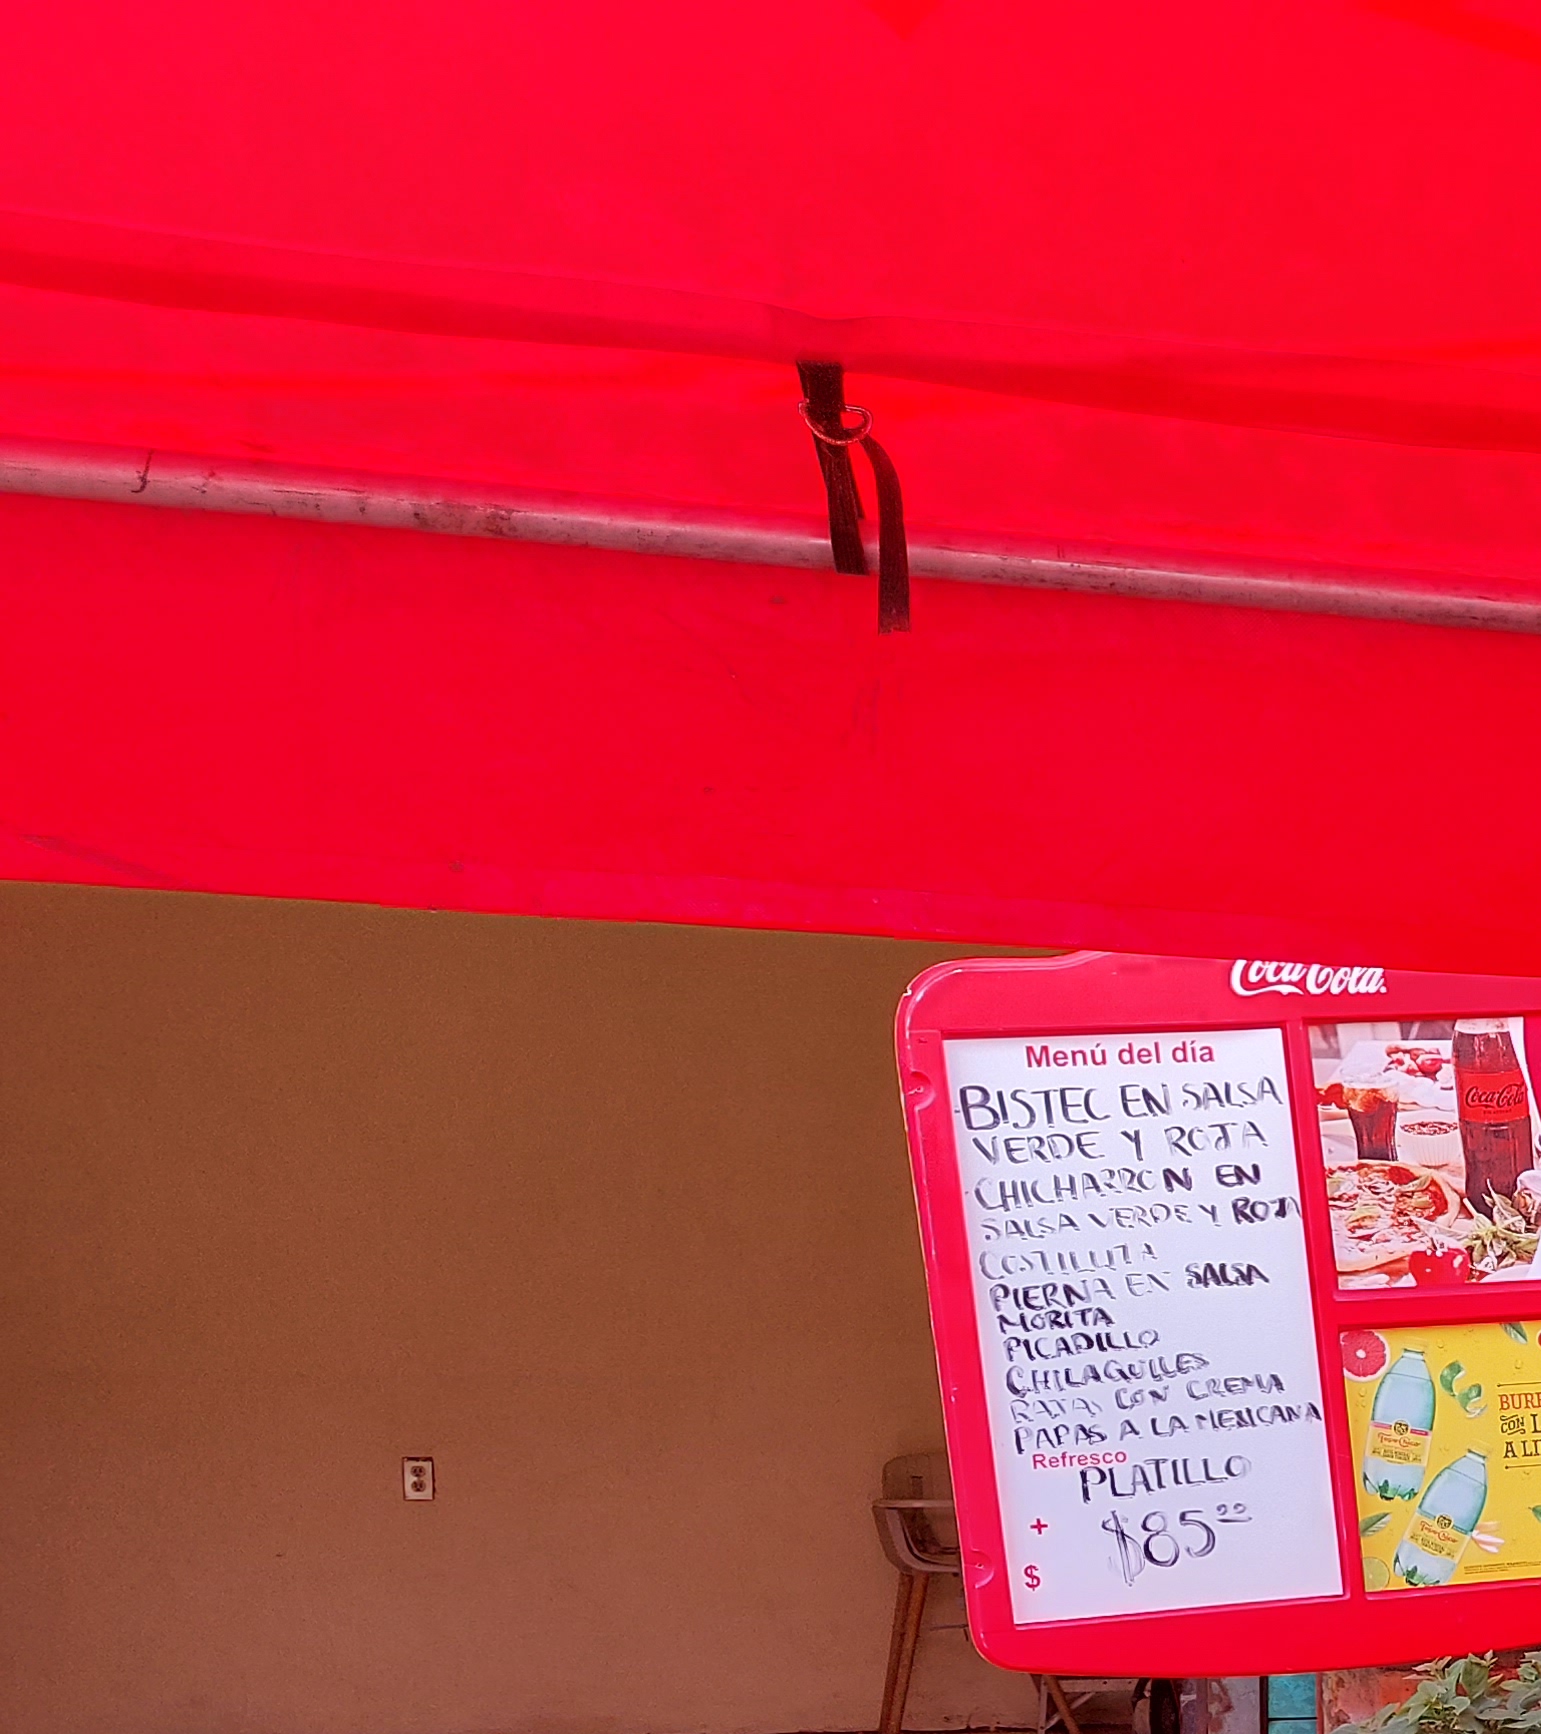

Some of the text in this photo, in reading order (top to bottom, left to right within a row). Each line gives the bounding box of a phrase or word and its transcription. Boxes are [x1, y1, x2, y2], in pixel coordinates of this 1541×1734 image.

[1025, 1040, 1215, 1068] Menú del día
[960, 1076, 1283, 1130] BISTEC EN SALSA
[973, 1131, 1104, 1165] VERDE
[1120, 1129, 1144, 1161] Y
[1215, 1163, 1261, 1186] EN
[980, 1212, 1080, 1240] SALSA
[1088, 1203, 1192, 1228] VERDE
[1199, 1203, 1222, 1227] Y
[990, 1278, 1116, 1312] PIERNA
[1185, 1262, 1270, 1288] SALSA
[997, 1307, 1115, 1334] MORITA
[1003, 1329, 1160, 1362] PICADILLO
[1114, 1386, 1168, 1410] CON
[1014, 1423, 1108, 1454] PAPAS
[1119, 1419, 1141, 1441] A
[1151, 1415, 1190, 1437] LA
[1500, 1416, 1525, 1434] CON
[1032, 1451, 1127, 1470] Refresco
[1503, 1441, 1518, 1459] A
[1079, 1455, 1251, 1504] PLATILLO
